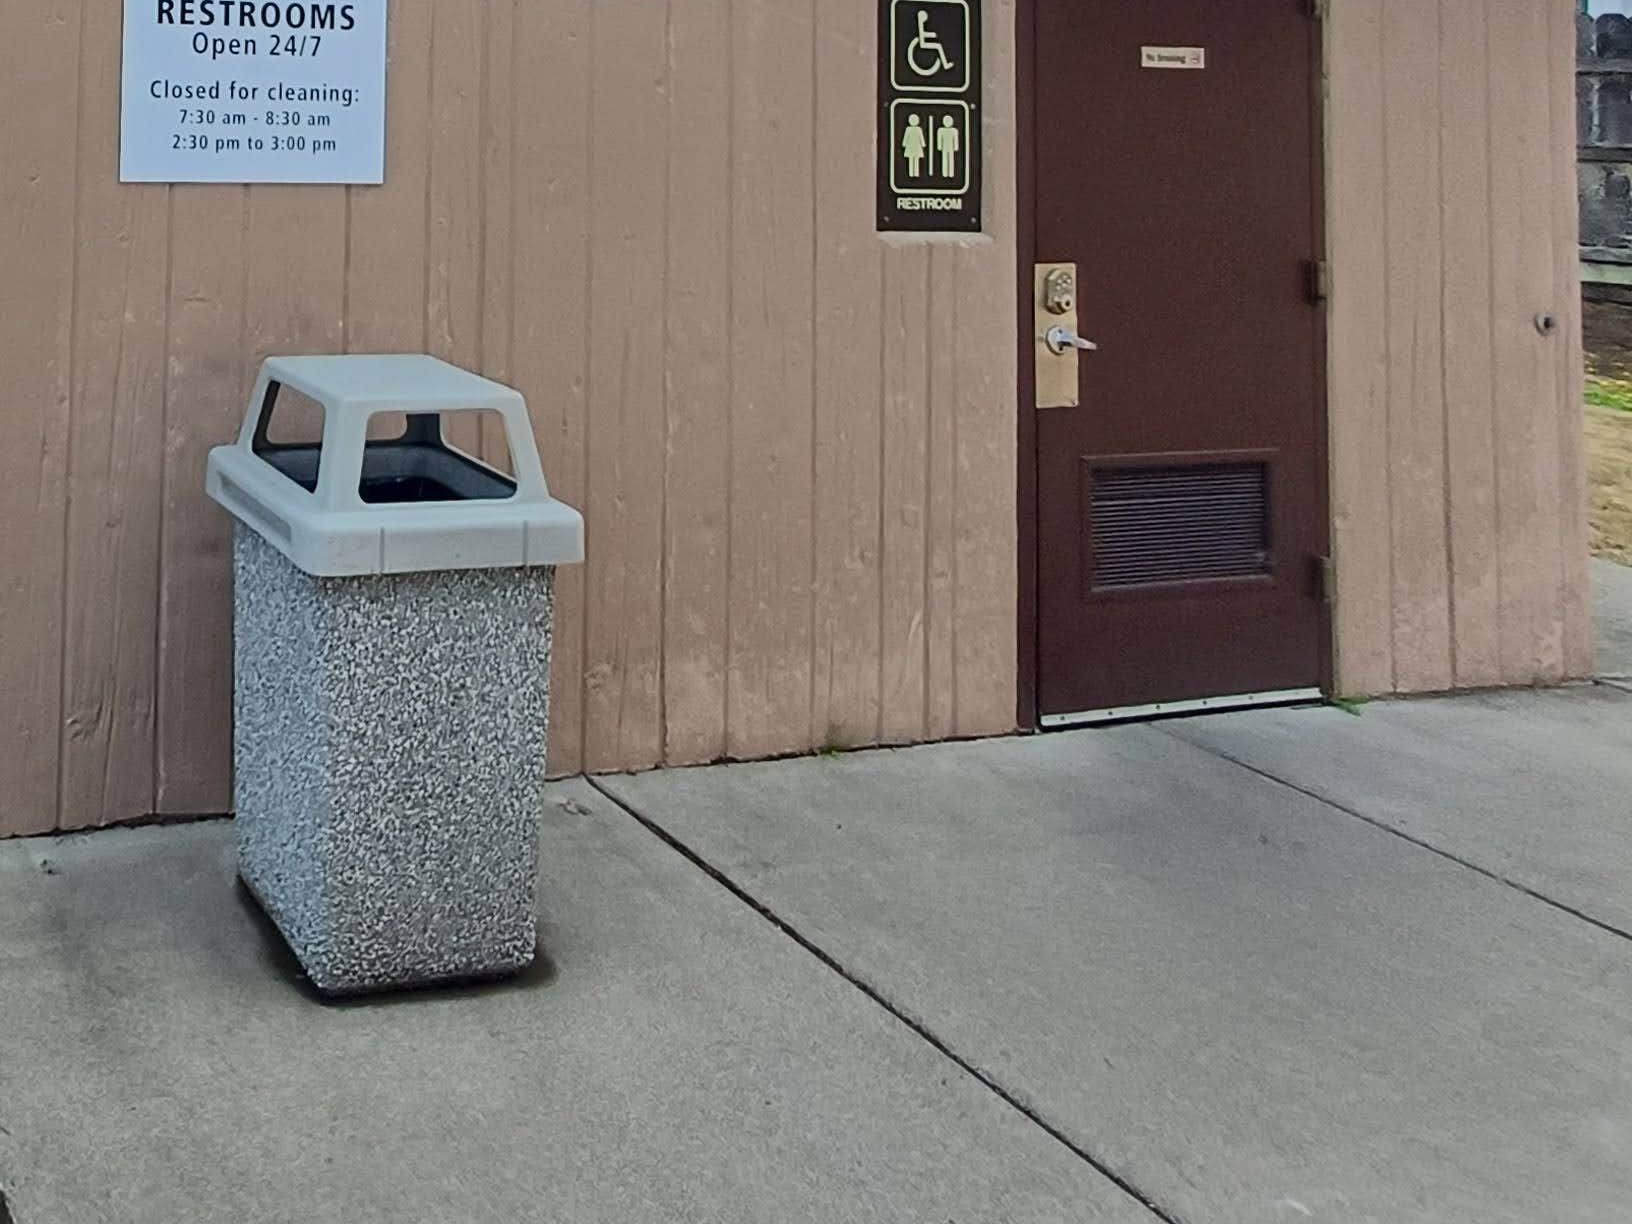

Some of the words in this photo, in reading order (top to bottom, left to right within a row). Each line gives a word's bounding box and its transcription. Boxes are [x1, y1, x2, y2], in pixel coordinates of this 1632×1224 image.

[192, 32, 257, 60] Open
[269, 35, 322, 56] 24/7
[150, 80, 220, 100] Closed
[229, 81, 259, 101] for
[268, 83, 360, 107] cleaning:
[179, 110, 216, 125] 7:30
[222, 112, 246, 125] am
[265, 111, 301, 126] 8:30
[308, 113, 330, 126] am
[172, 135, 208, 150] 2:30
[216, 137, 240, 153] pm
[248, 136, 263, 151] to
[271, 136, 305, 151] 3:00
[312, 138, 336, 154] pm
[897, 197, 962, 210] RESTROOM
